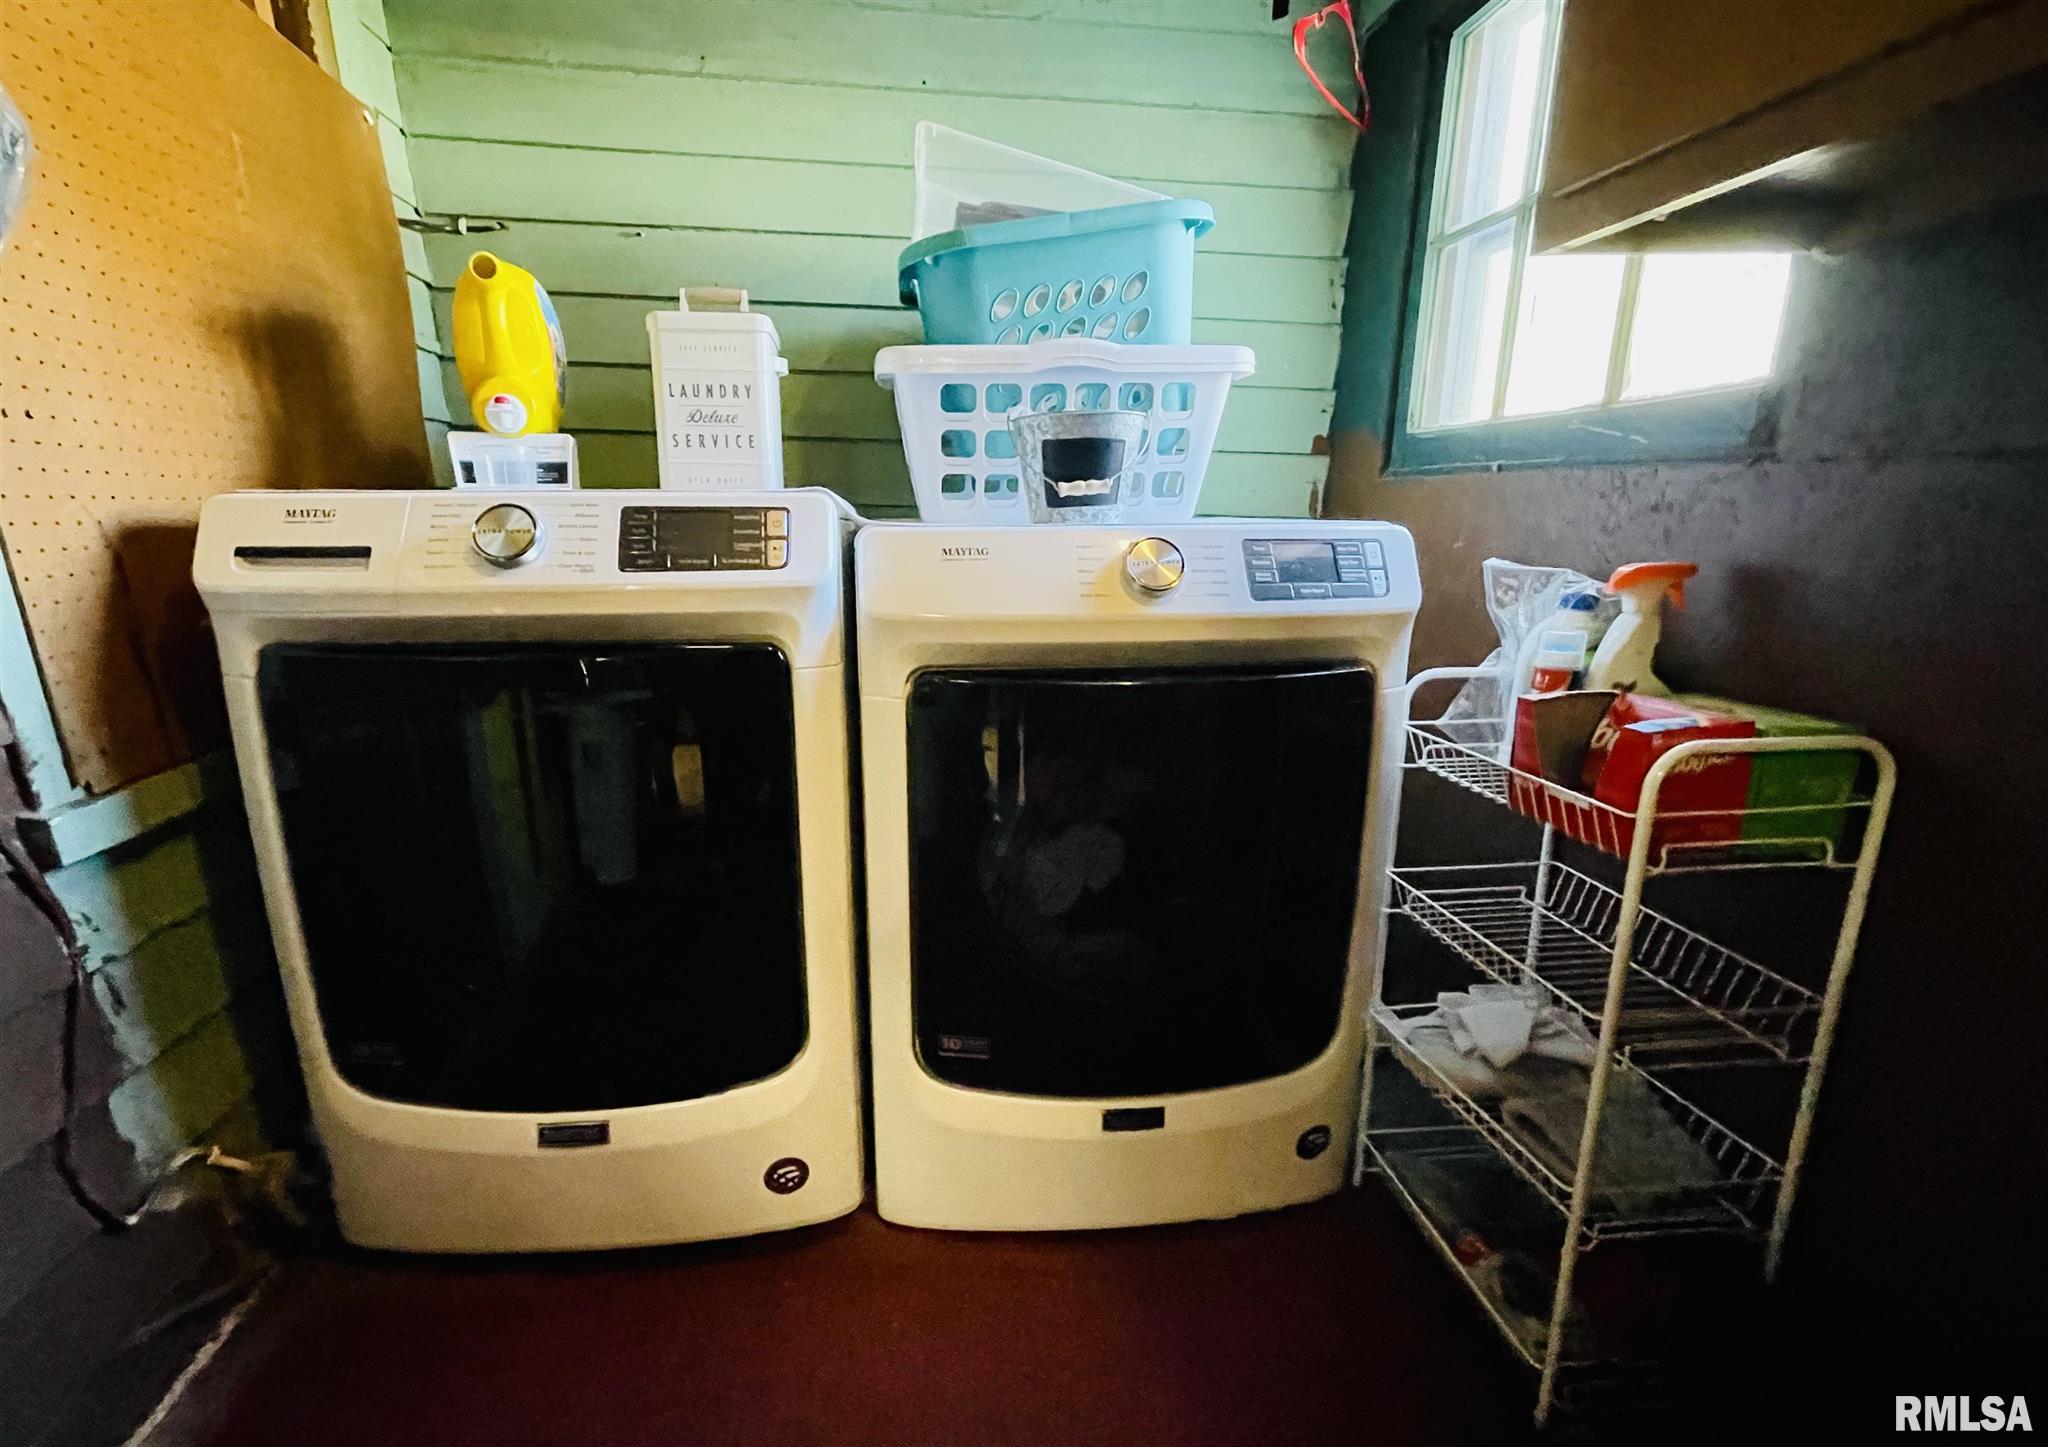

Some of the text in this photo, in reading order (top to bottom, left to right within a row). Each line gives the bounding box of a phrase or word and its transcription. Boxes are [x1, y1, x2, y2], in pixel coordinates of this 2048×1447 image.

[667, 382, 753, 400] LAUNDRY
[686, 408, 740, 425] Deluxe
[672, 433, 756, 449] SERVICE
[284, 508, 337, 519] MAYTAG
[941, 547, 990, 556] MAYTAG
